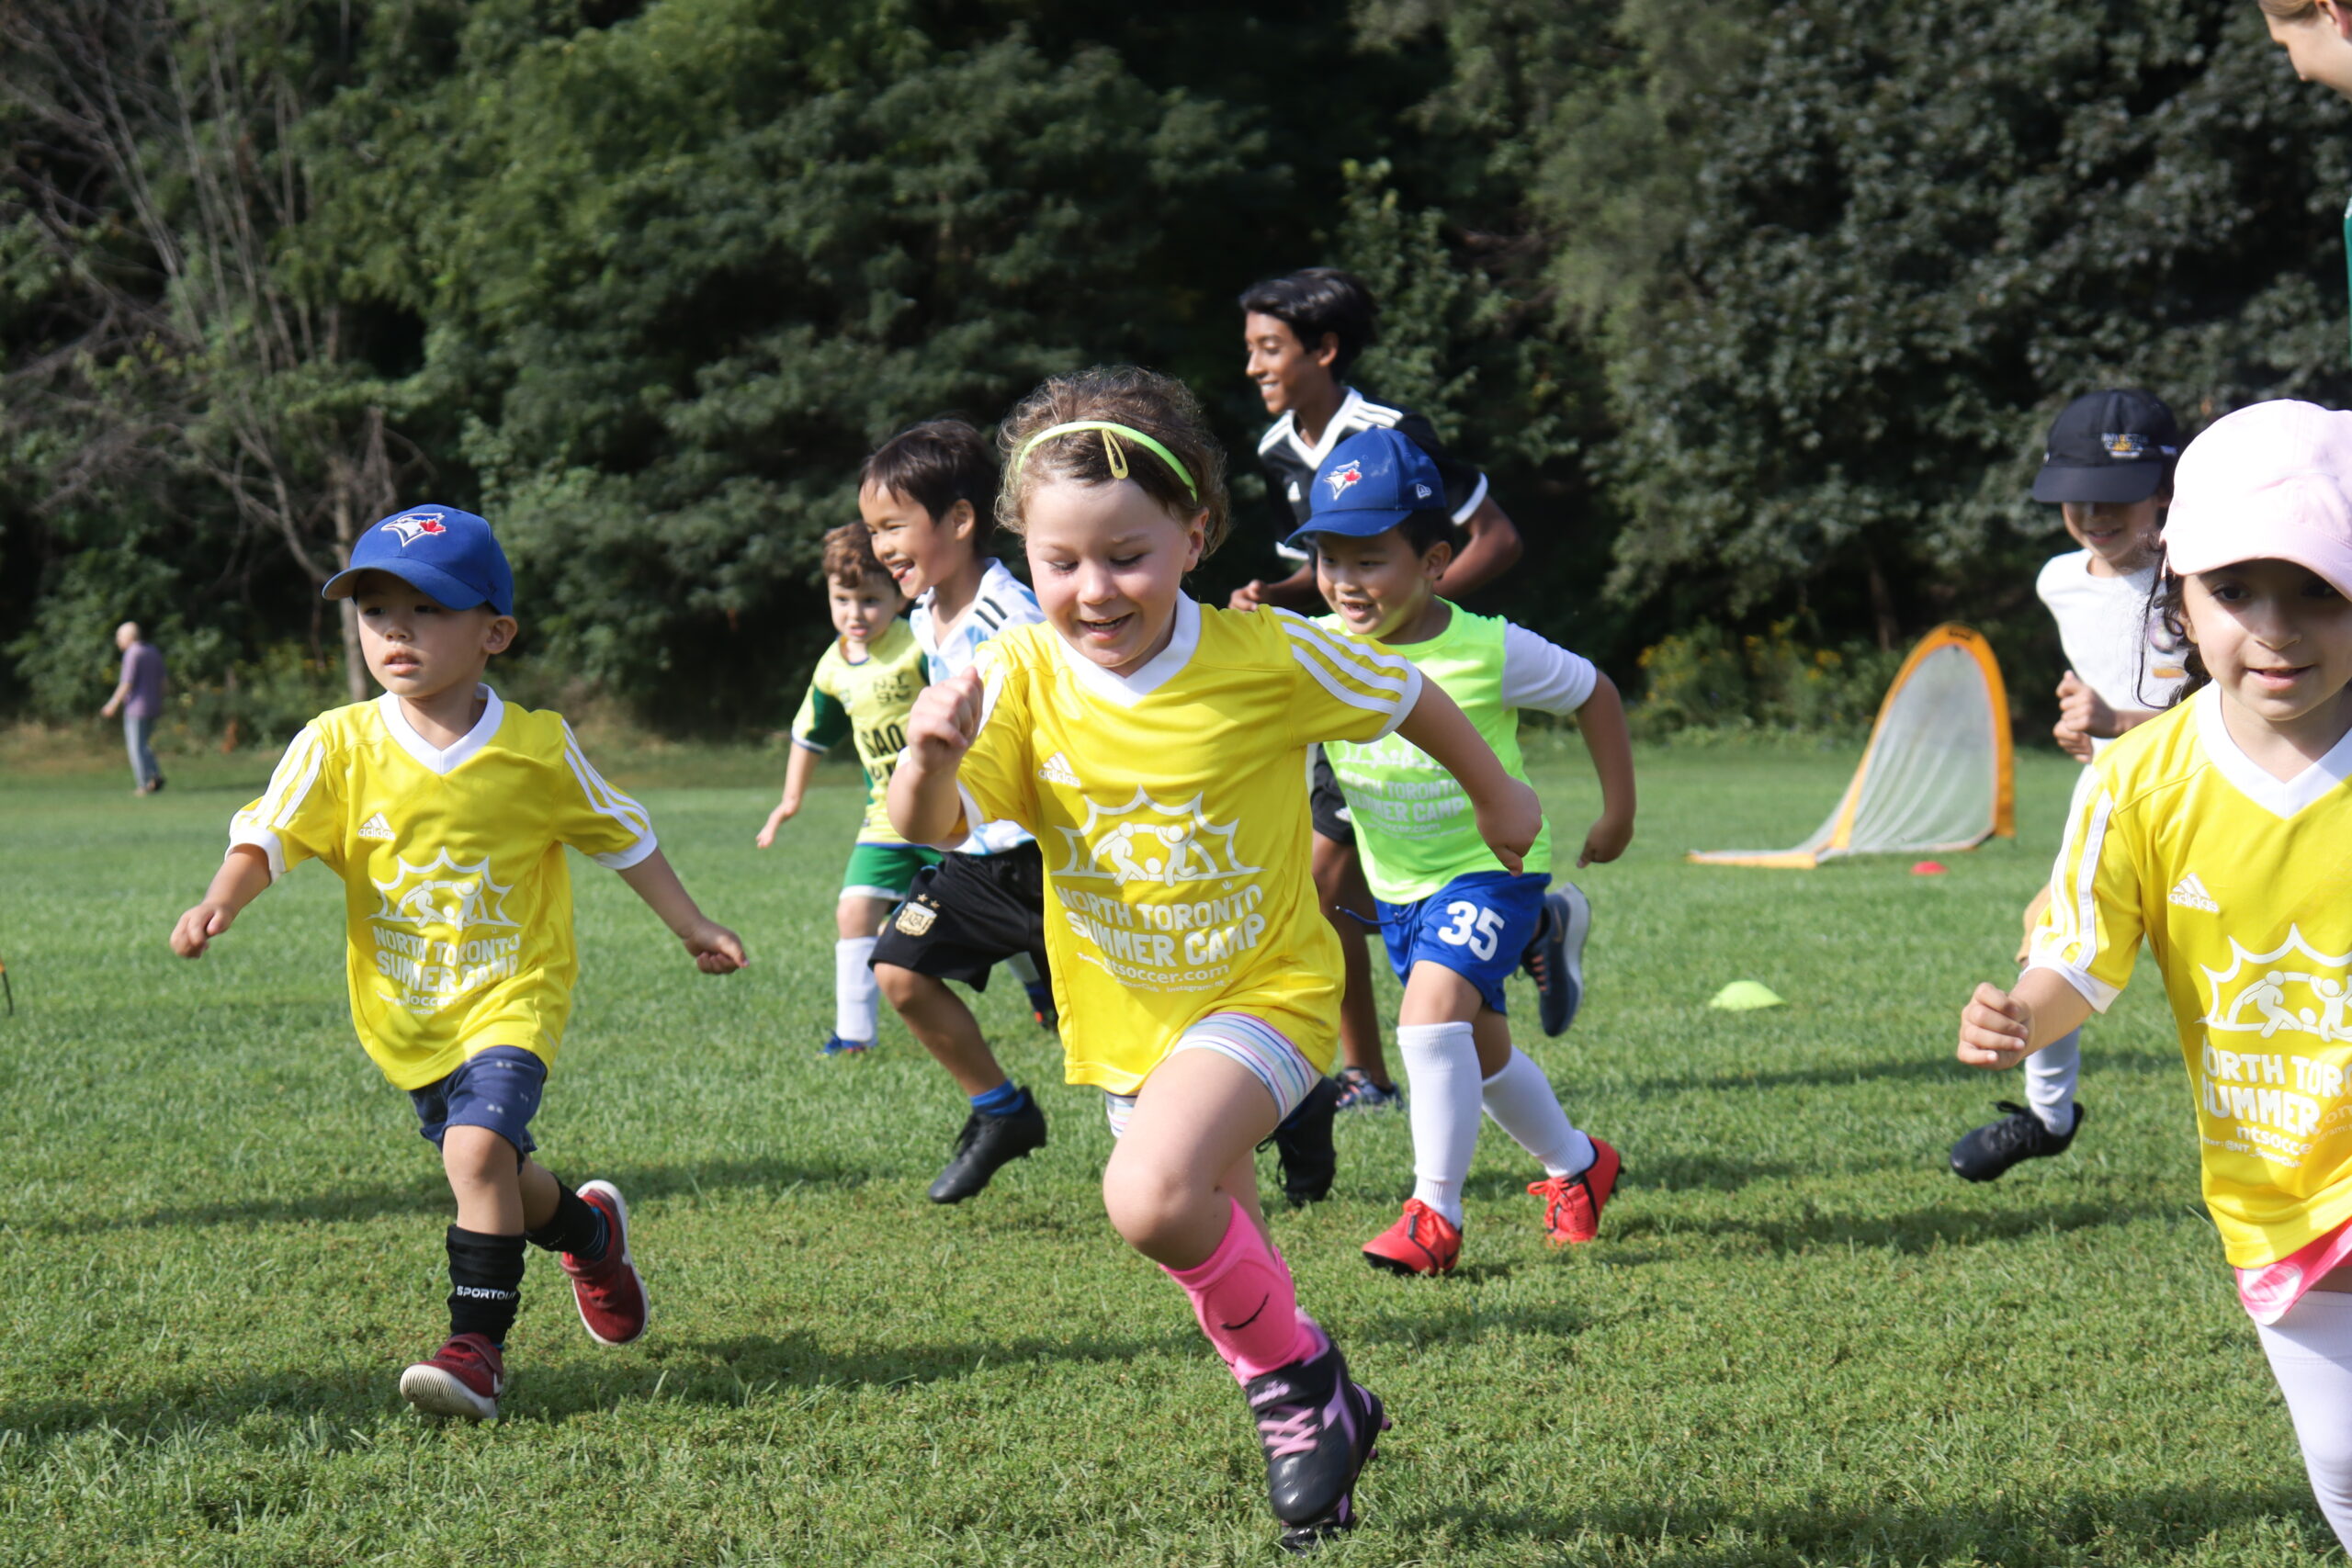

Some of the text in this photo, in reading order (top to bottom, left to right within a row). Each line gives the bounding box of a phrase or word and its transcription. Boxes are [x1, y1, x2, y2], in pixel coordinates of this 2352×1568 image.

[1037, 769, 1081, 788] adidas
[1413, 796, 1466, 822] CAMP
[358, 827, 396, 840] adidas
[1056, 884, 1263, 931] NORTH TORONTO
[2168, 892, 2220, 913] adidas
[373, 925, 426, 963] NORTH
[1065, 911, 1267, 967] SUMMER CAMP
[1438, 900, 1505, 961] 35
[2201, 1073, 2321, 1138] UMMER
